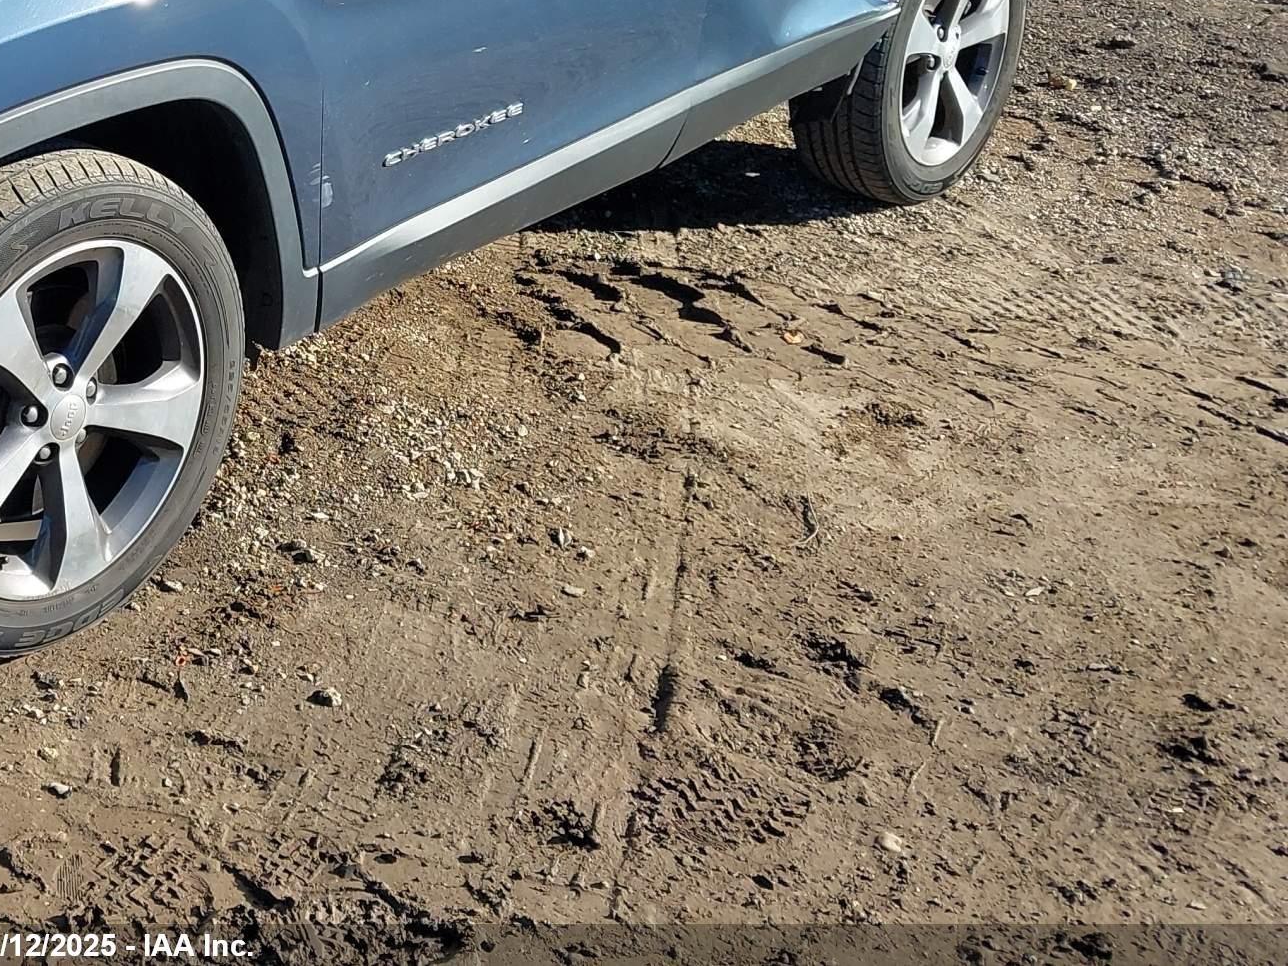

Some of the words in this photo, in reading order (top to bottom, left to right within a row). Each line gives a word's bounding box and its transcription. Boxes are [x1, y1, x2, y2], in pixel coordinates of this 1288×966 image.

[382, 100, 525, 168] CHEROKEE
[57, 196, 195, 237] KELLY
[59, 401, 79, 437] Jeep
